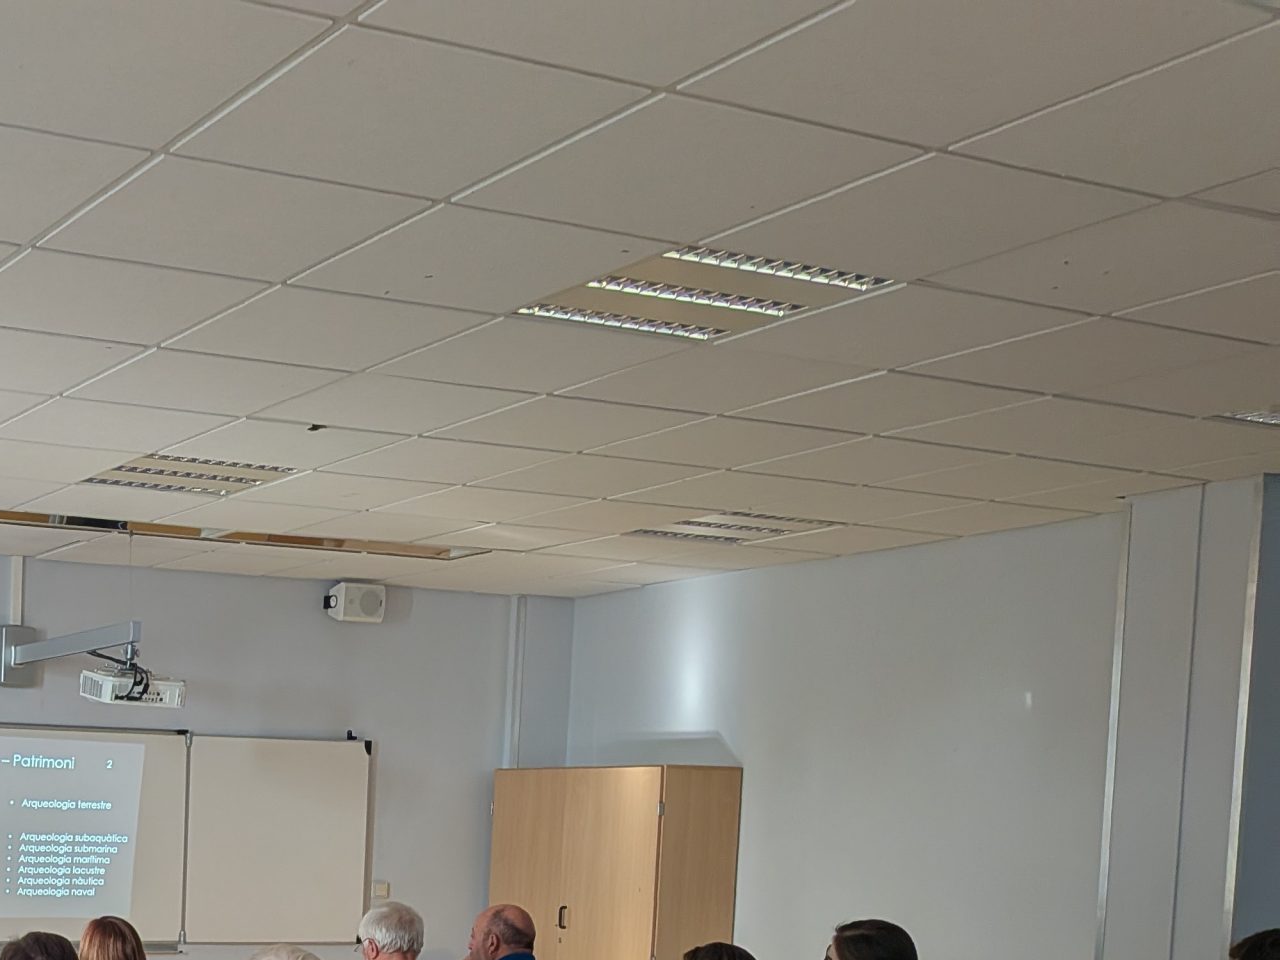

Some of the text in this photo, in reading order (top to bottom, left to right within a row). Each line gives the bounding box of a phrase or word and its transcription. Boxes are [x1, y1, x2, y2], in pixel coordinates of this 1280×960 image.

[13, 754, 74, 770] Patrimoni
[107, 760, 112, 769] 2
[22, 799, 111, 810] Arqueologia terrestre
[20, 833, 73, 843] Arqueologia
[19, 844, 117, 854] Arqueologia submarina
[19, 855, 71, 865] Arqueologia
[18, 866, 105, 875] Arqueologia lacustre
[18, 877, 104, 886] Arqueologia nàutica
[17, 888, 95, 897] Arqueologia naval
